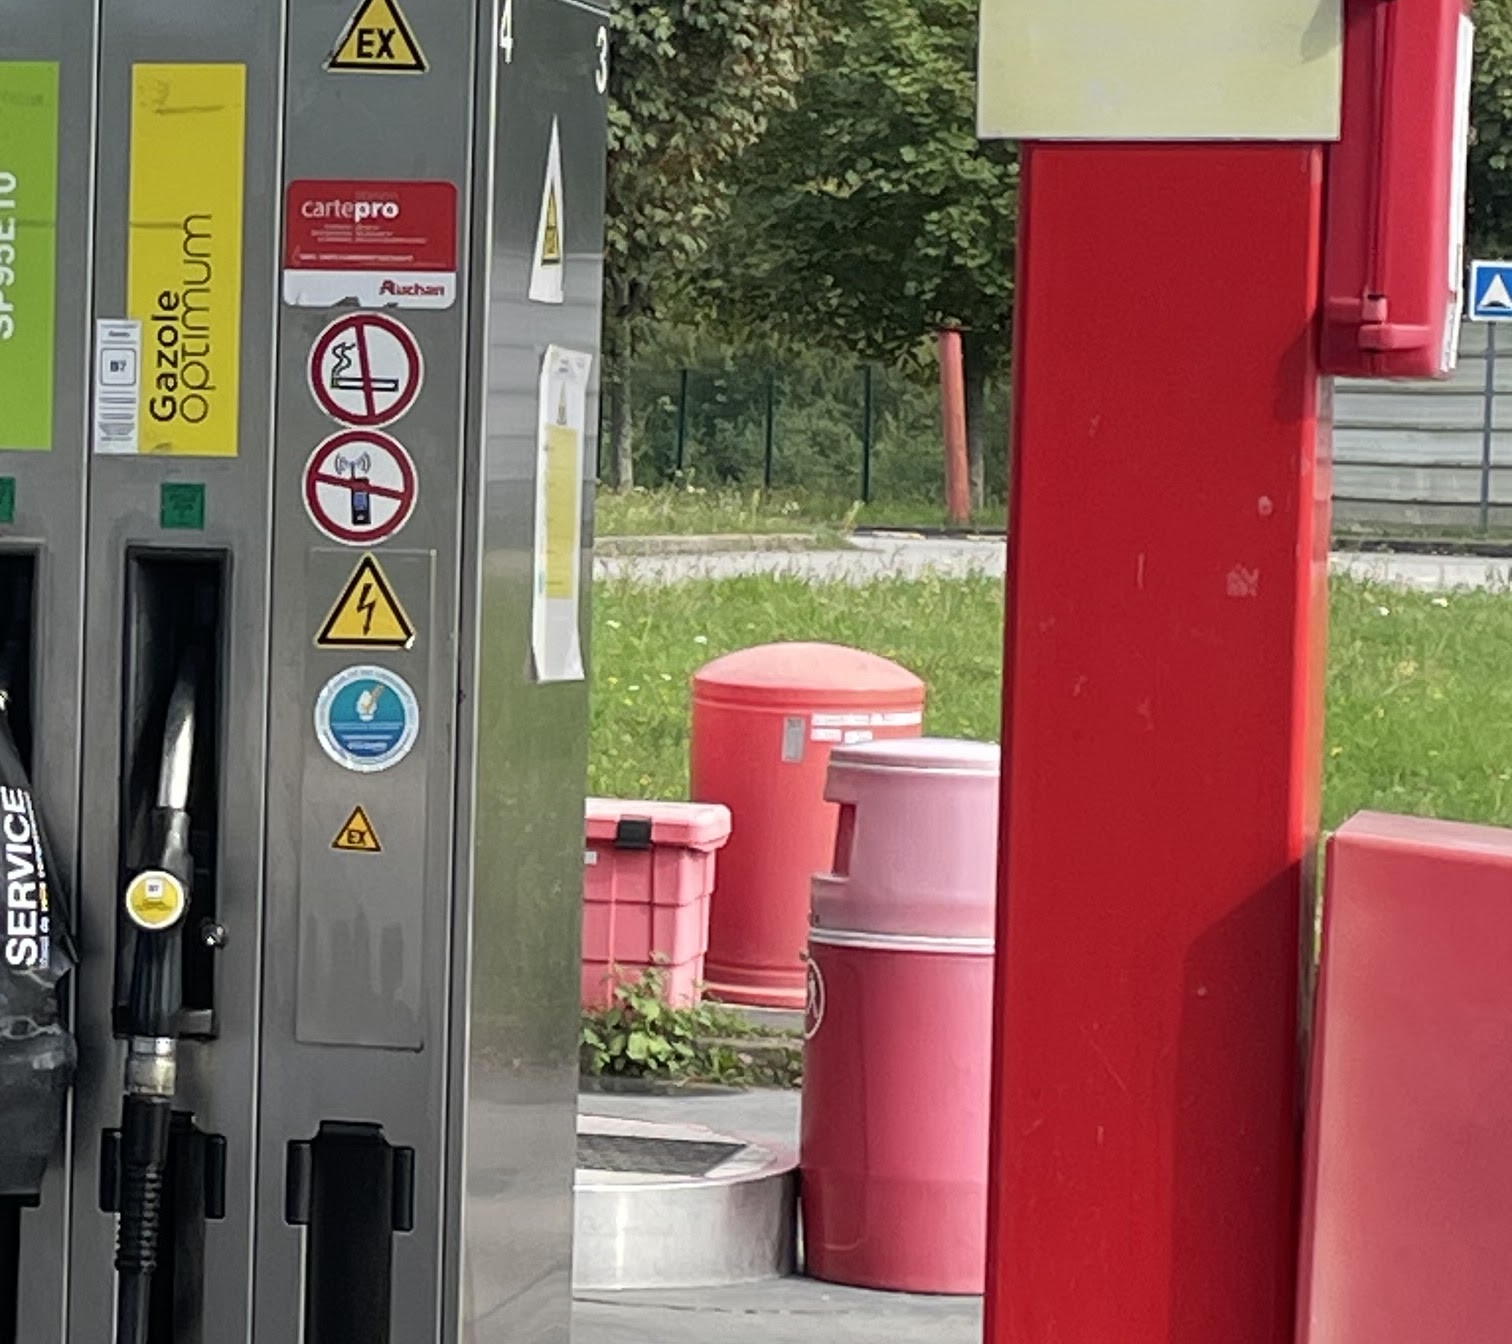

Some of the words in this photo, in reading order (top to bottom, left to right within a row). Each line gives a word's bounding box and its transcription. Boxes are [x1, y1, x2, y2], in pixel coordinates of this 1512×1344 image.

[356, 28, 395, 59] EX
[596, 26, 607, 94] 3
[379, 280, 444, 296] Auchan
[110, 360, 127, 372] B7
[150, 289, 180, 422] Gazole
[347, 829, 367, 846] EX
[0, 786, 38, 966] SERVICE
